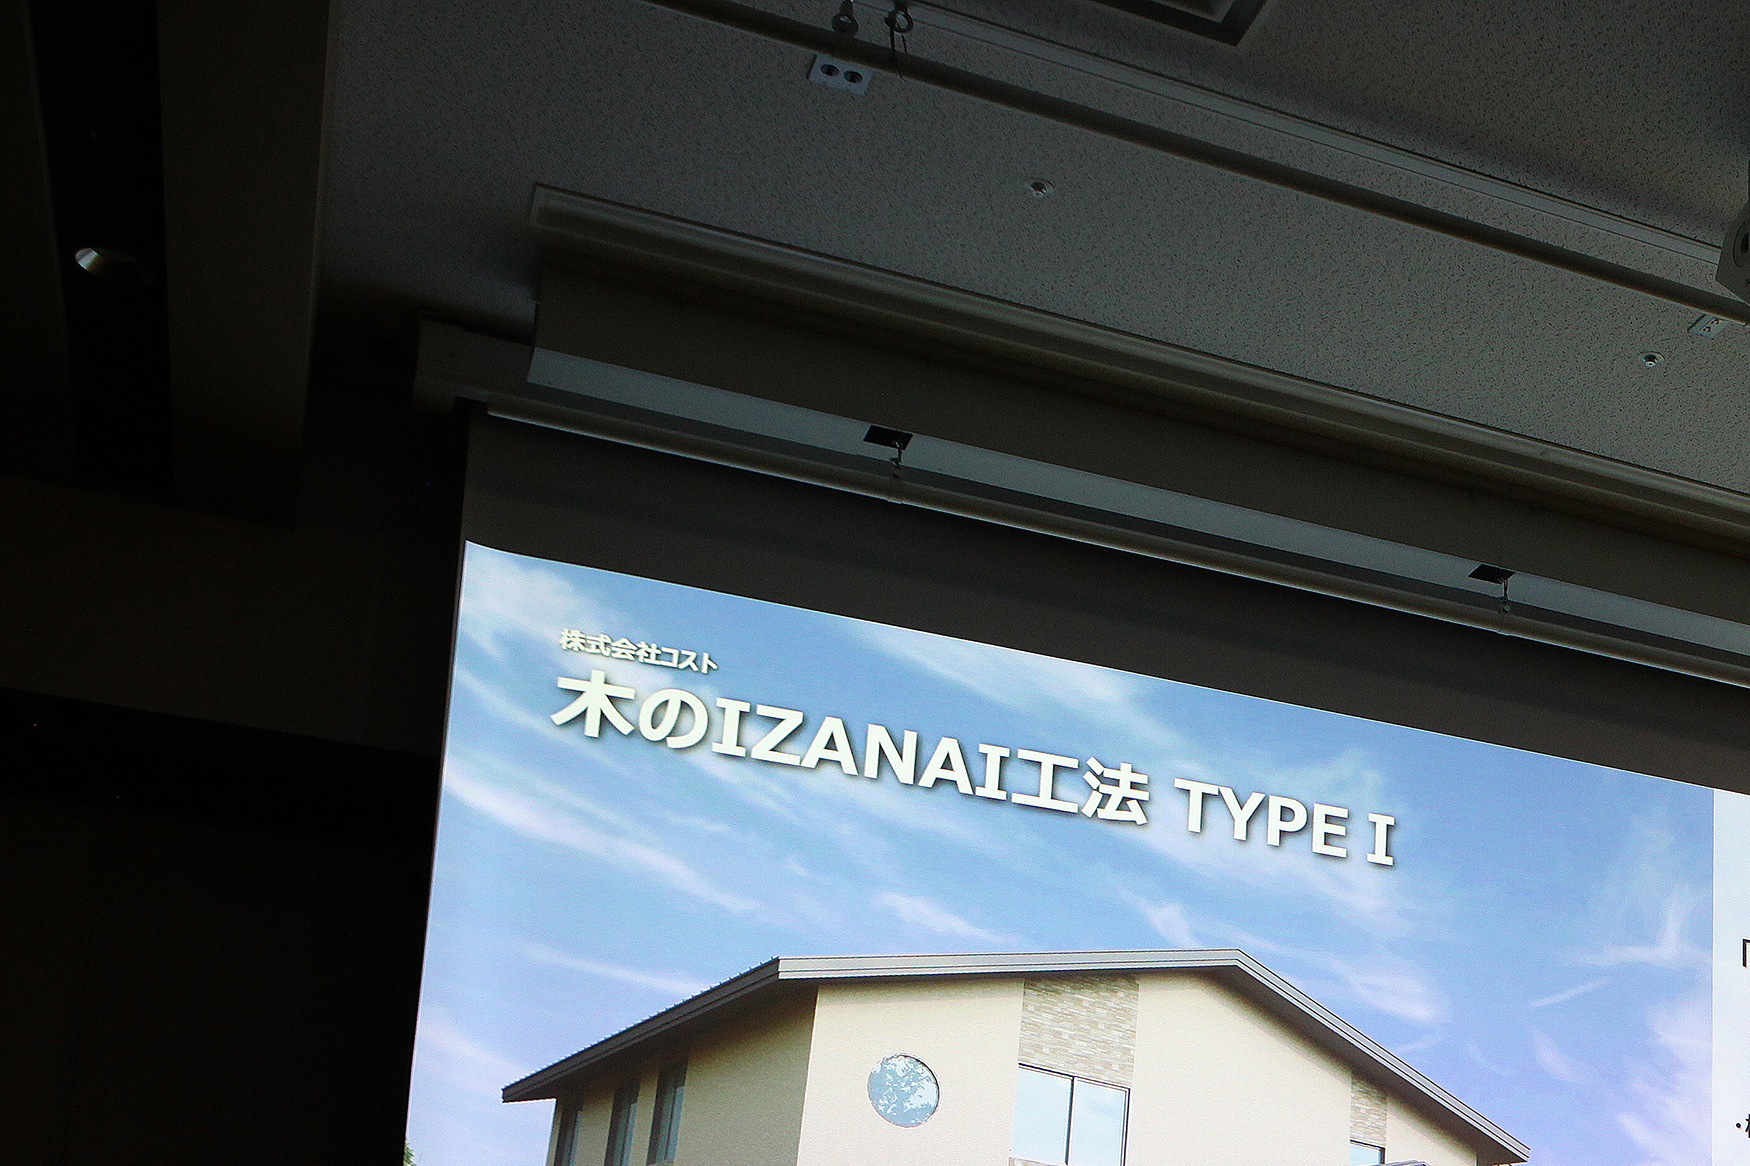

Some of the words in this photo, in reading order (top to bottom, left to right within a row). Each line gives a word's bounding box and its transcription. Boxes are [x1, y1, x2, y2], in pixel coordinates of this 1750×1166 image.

[559, 627, 718, 673] 株式会社コスト
[550, 671, 1151, 826] 木のIZANAI工法
[1174, 777, 1349, 858] TYPE
